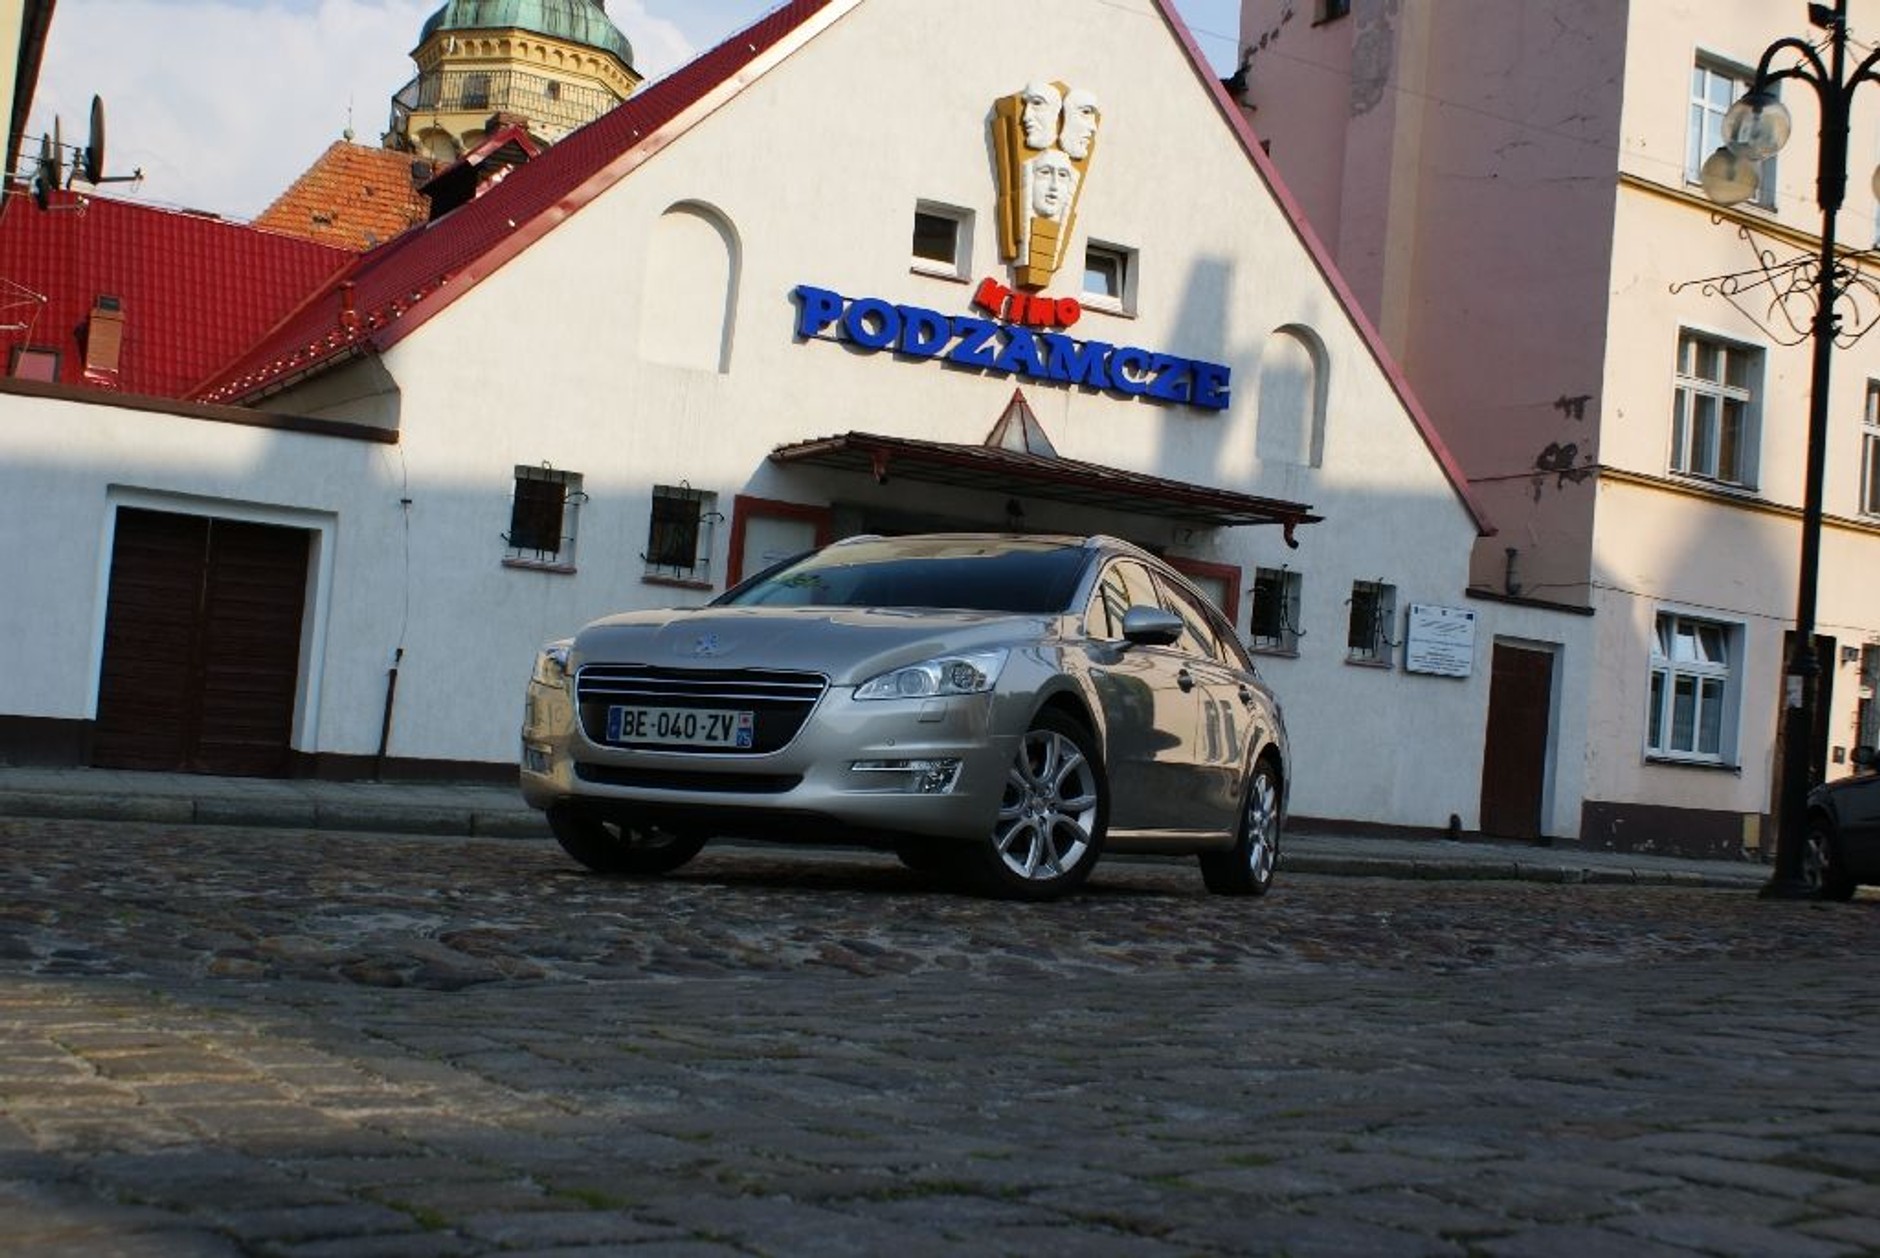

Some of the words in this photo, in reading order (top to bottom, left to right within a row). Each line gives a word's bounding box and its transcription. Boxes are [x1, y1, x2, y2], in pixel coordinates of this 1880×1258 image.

[976, 276, 1082, 328] KINO
[794, 284, 1232, 411] PODZAMCZE
[622, 710, 734, 742] BE-040-ZV
